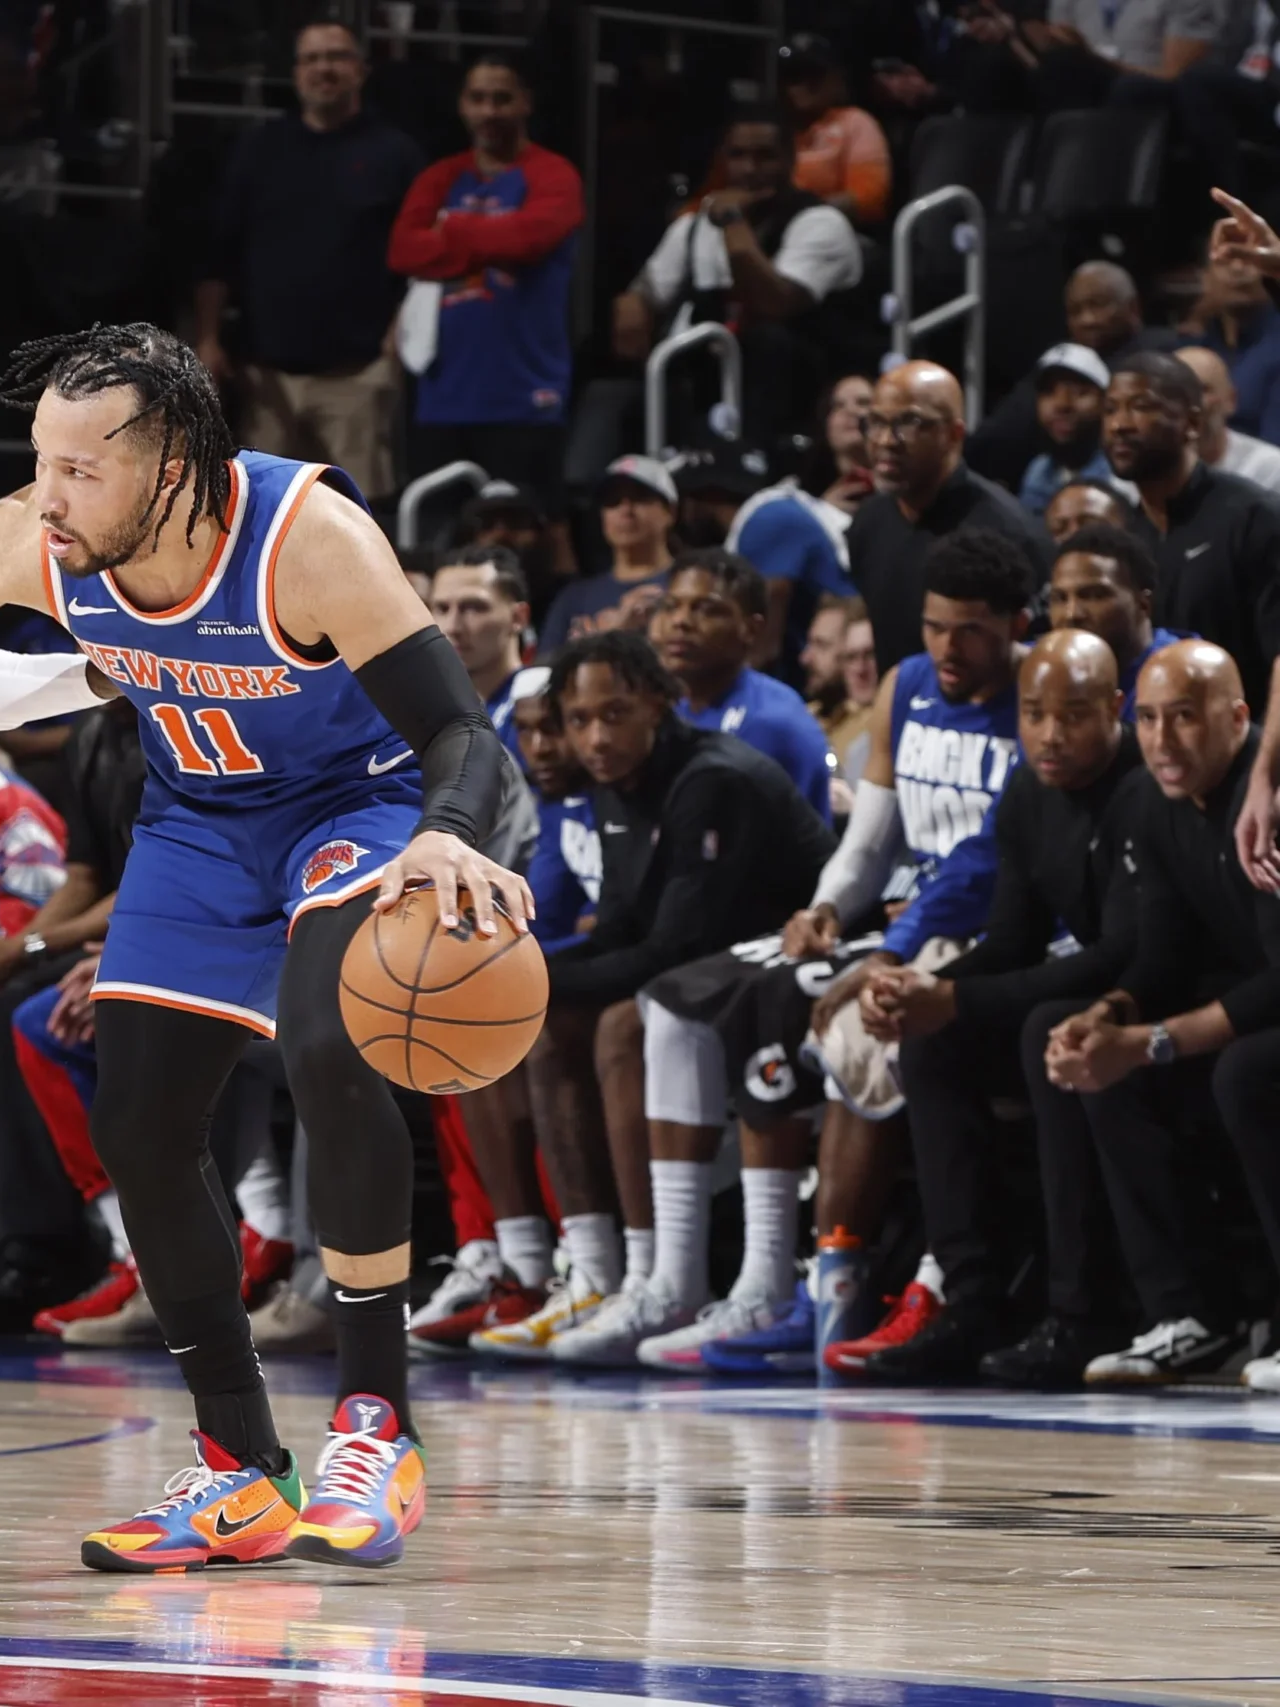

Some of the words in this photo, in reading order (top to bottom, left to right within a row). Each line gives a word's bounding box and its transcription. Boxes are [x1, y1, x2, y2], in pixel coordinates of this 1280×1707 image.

[197, 625, 222, 635] abu
[223, 625, 260, 635] dhabi
[159, 656, 302, 700] YORK
[148, 702, 265, 776] 11
